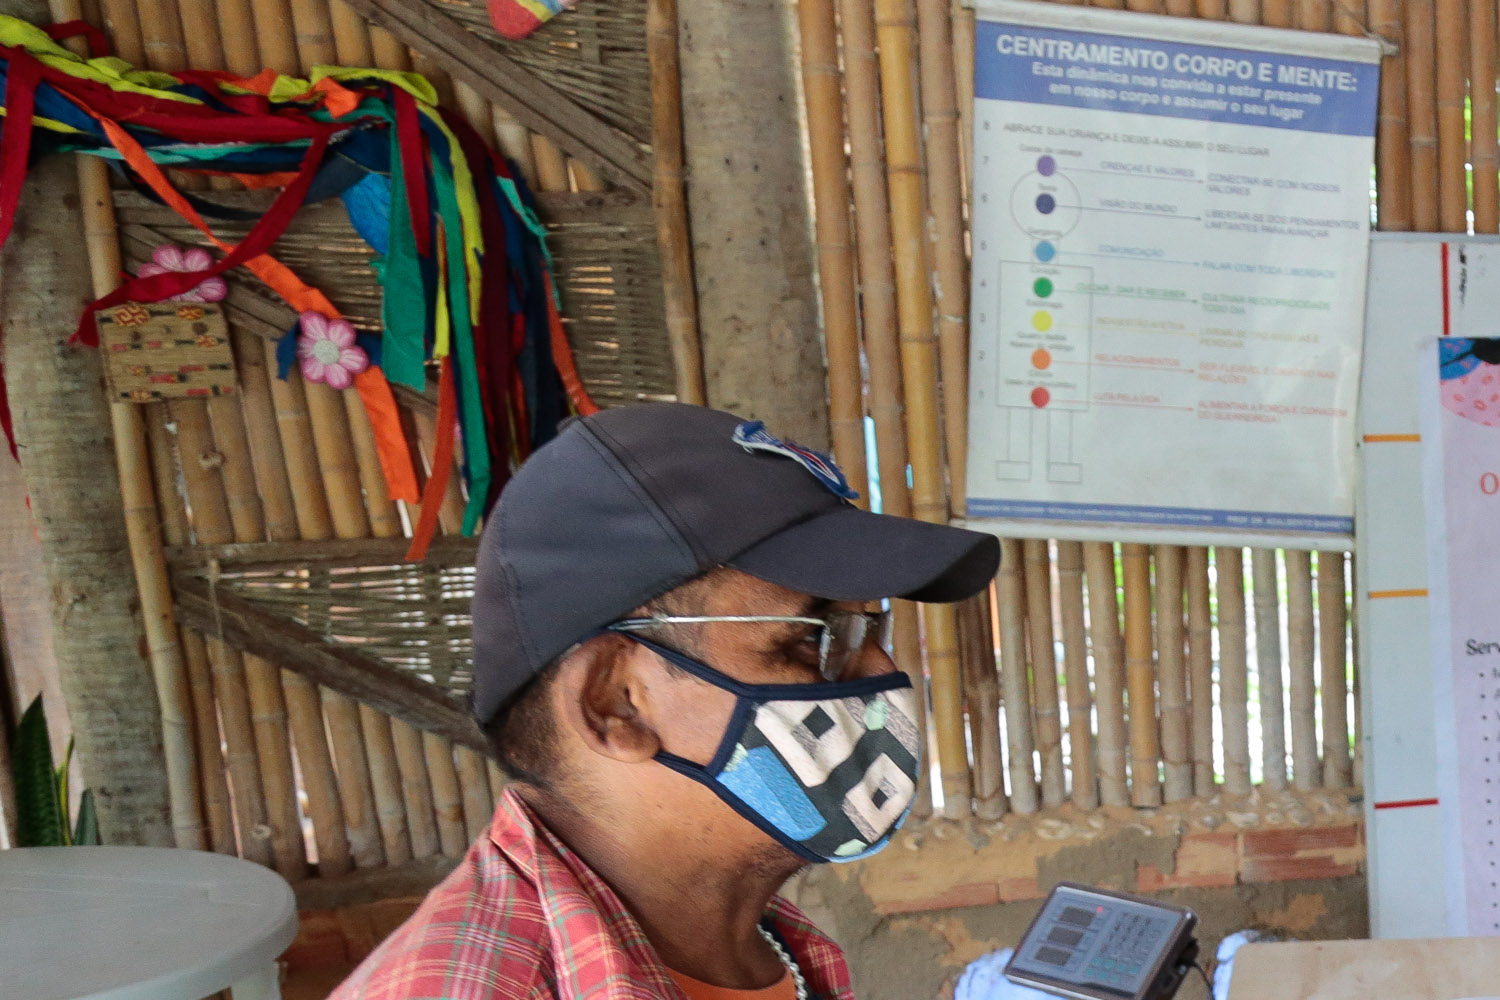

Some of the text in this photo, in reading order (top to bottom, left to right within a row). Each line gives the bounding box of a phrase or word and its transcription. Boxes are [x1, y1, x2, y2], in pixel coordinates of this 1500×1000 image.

[996, 34, 1357, 92] CENTRAMENTO CORPO E MENTE:
[1031, 61, 1322, 105] Esta dinâmica nos convida a estar presente
[1049, 84, 1071, 95] em
[1073, 86, 1117, 100] nosso
[1119, 90, 1160, 106] corpo
[1173, 95, 1228, 111] assumir
[1230, 102, 1241, 112] o
[1242, 103, 1268, 116] seu
[1269, 104, 1304, 121] lugar
